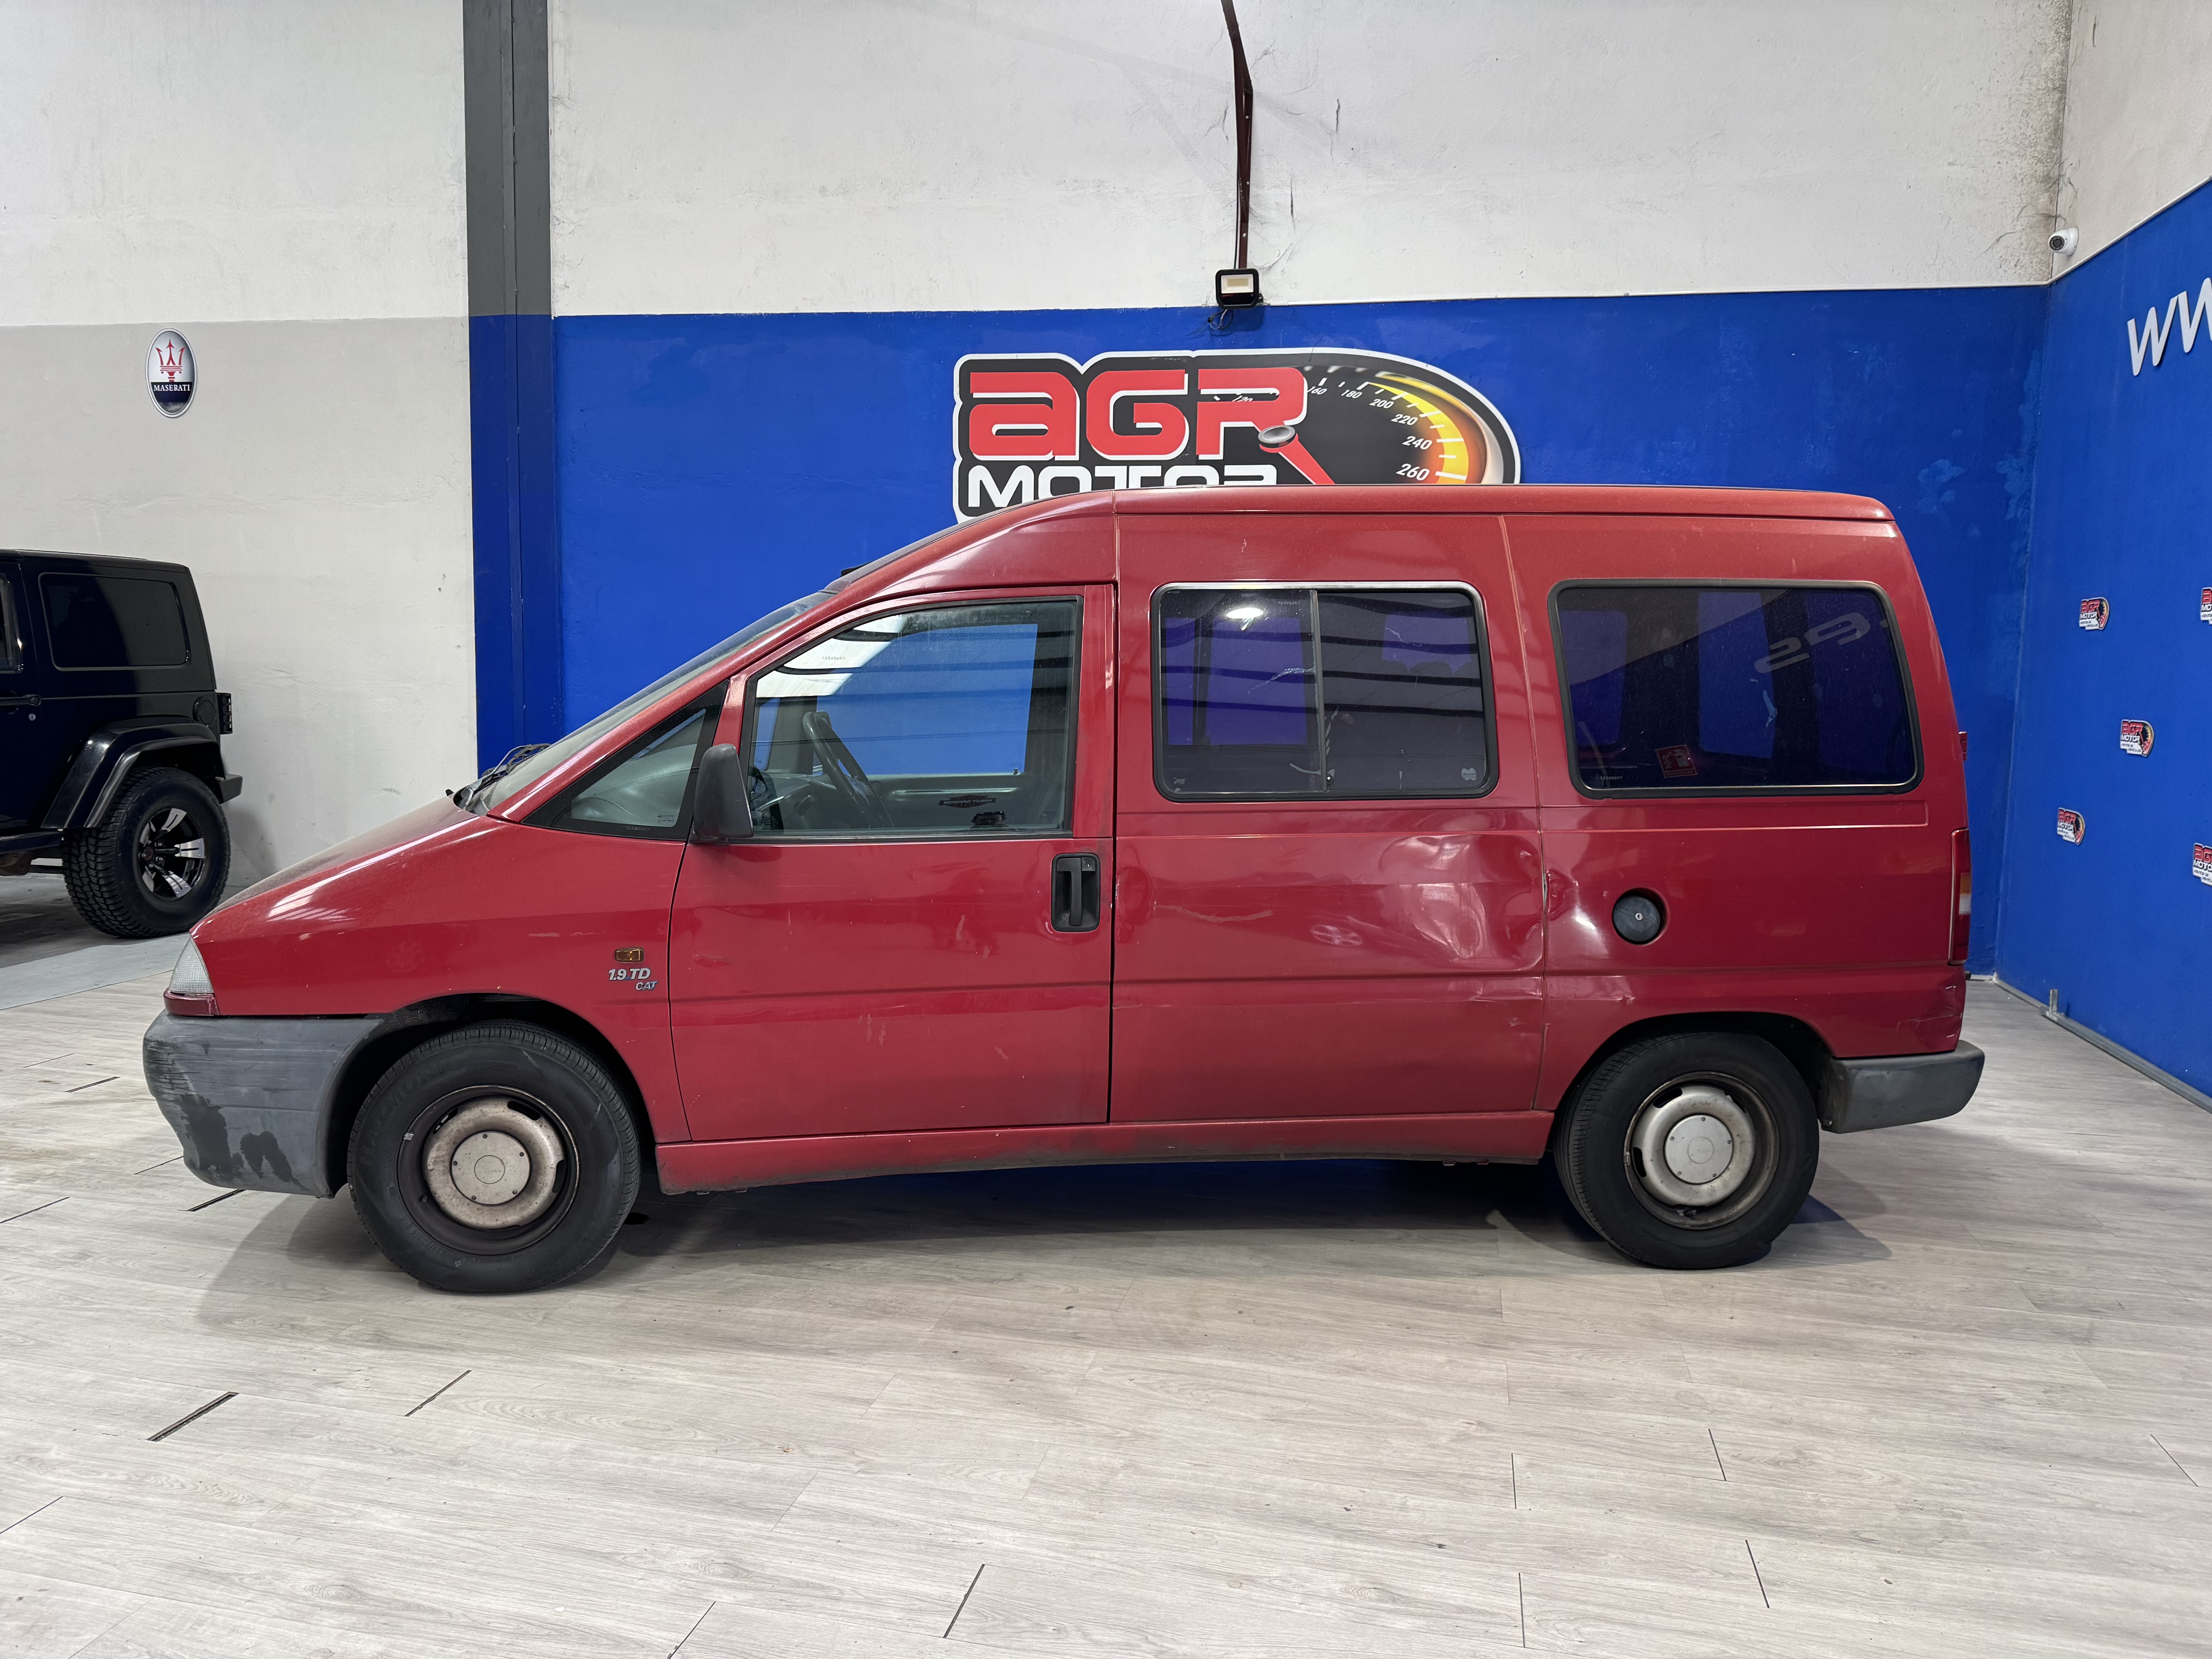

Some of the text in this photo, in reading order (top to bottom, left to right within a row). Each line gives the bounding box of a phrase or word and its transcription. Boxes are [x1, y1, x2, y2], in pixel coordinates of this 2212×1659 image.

[1307, 386, 1328, 395] 160
[1341, 390, 1362, 399] 180
[1369, 398, 1394, 409] 200
[1391, 414, 1418, 426] 220
[1402, 436, 1432, 450] 240
[1396, 463, 1430, 481] 260
[608, 968, 651, 981] 1.9 TD
[635, 981, 658, 990] CAT
